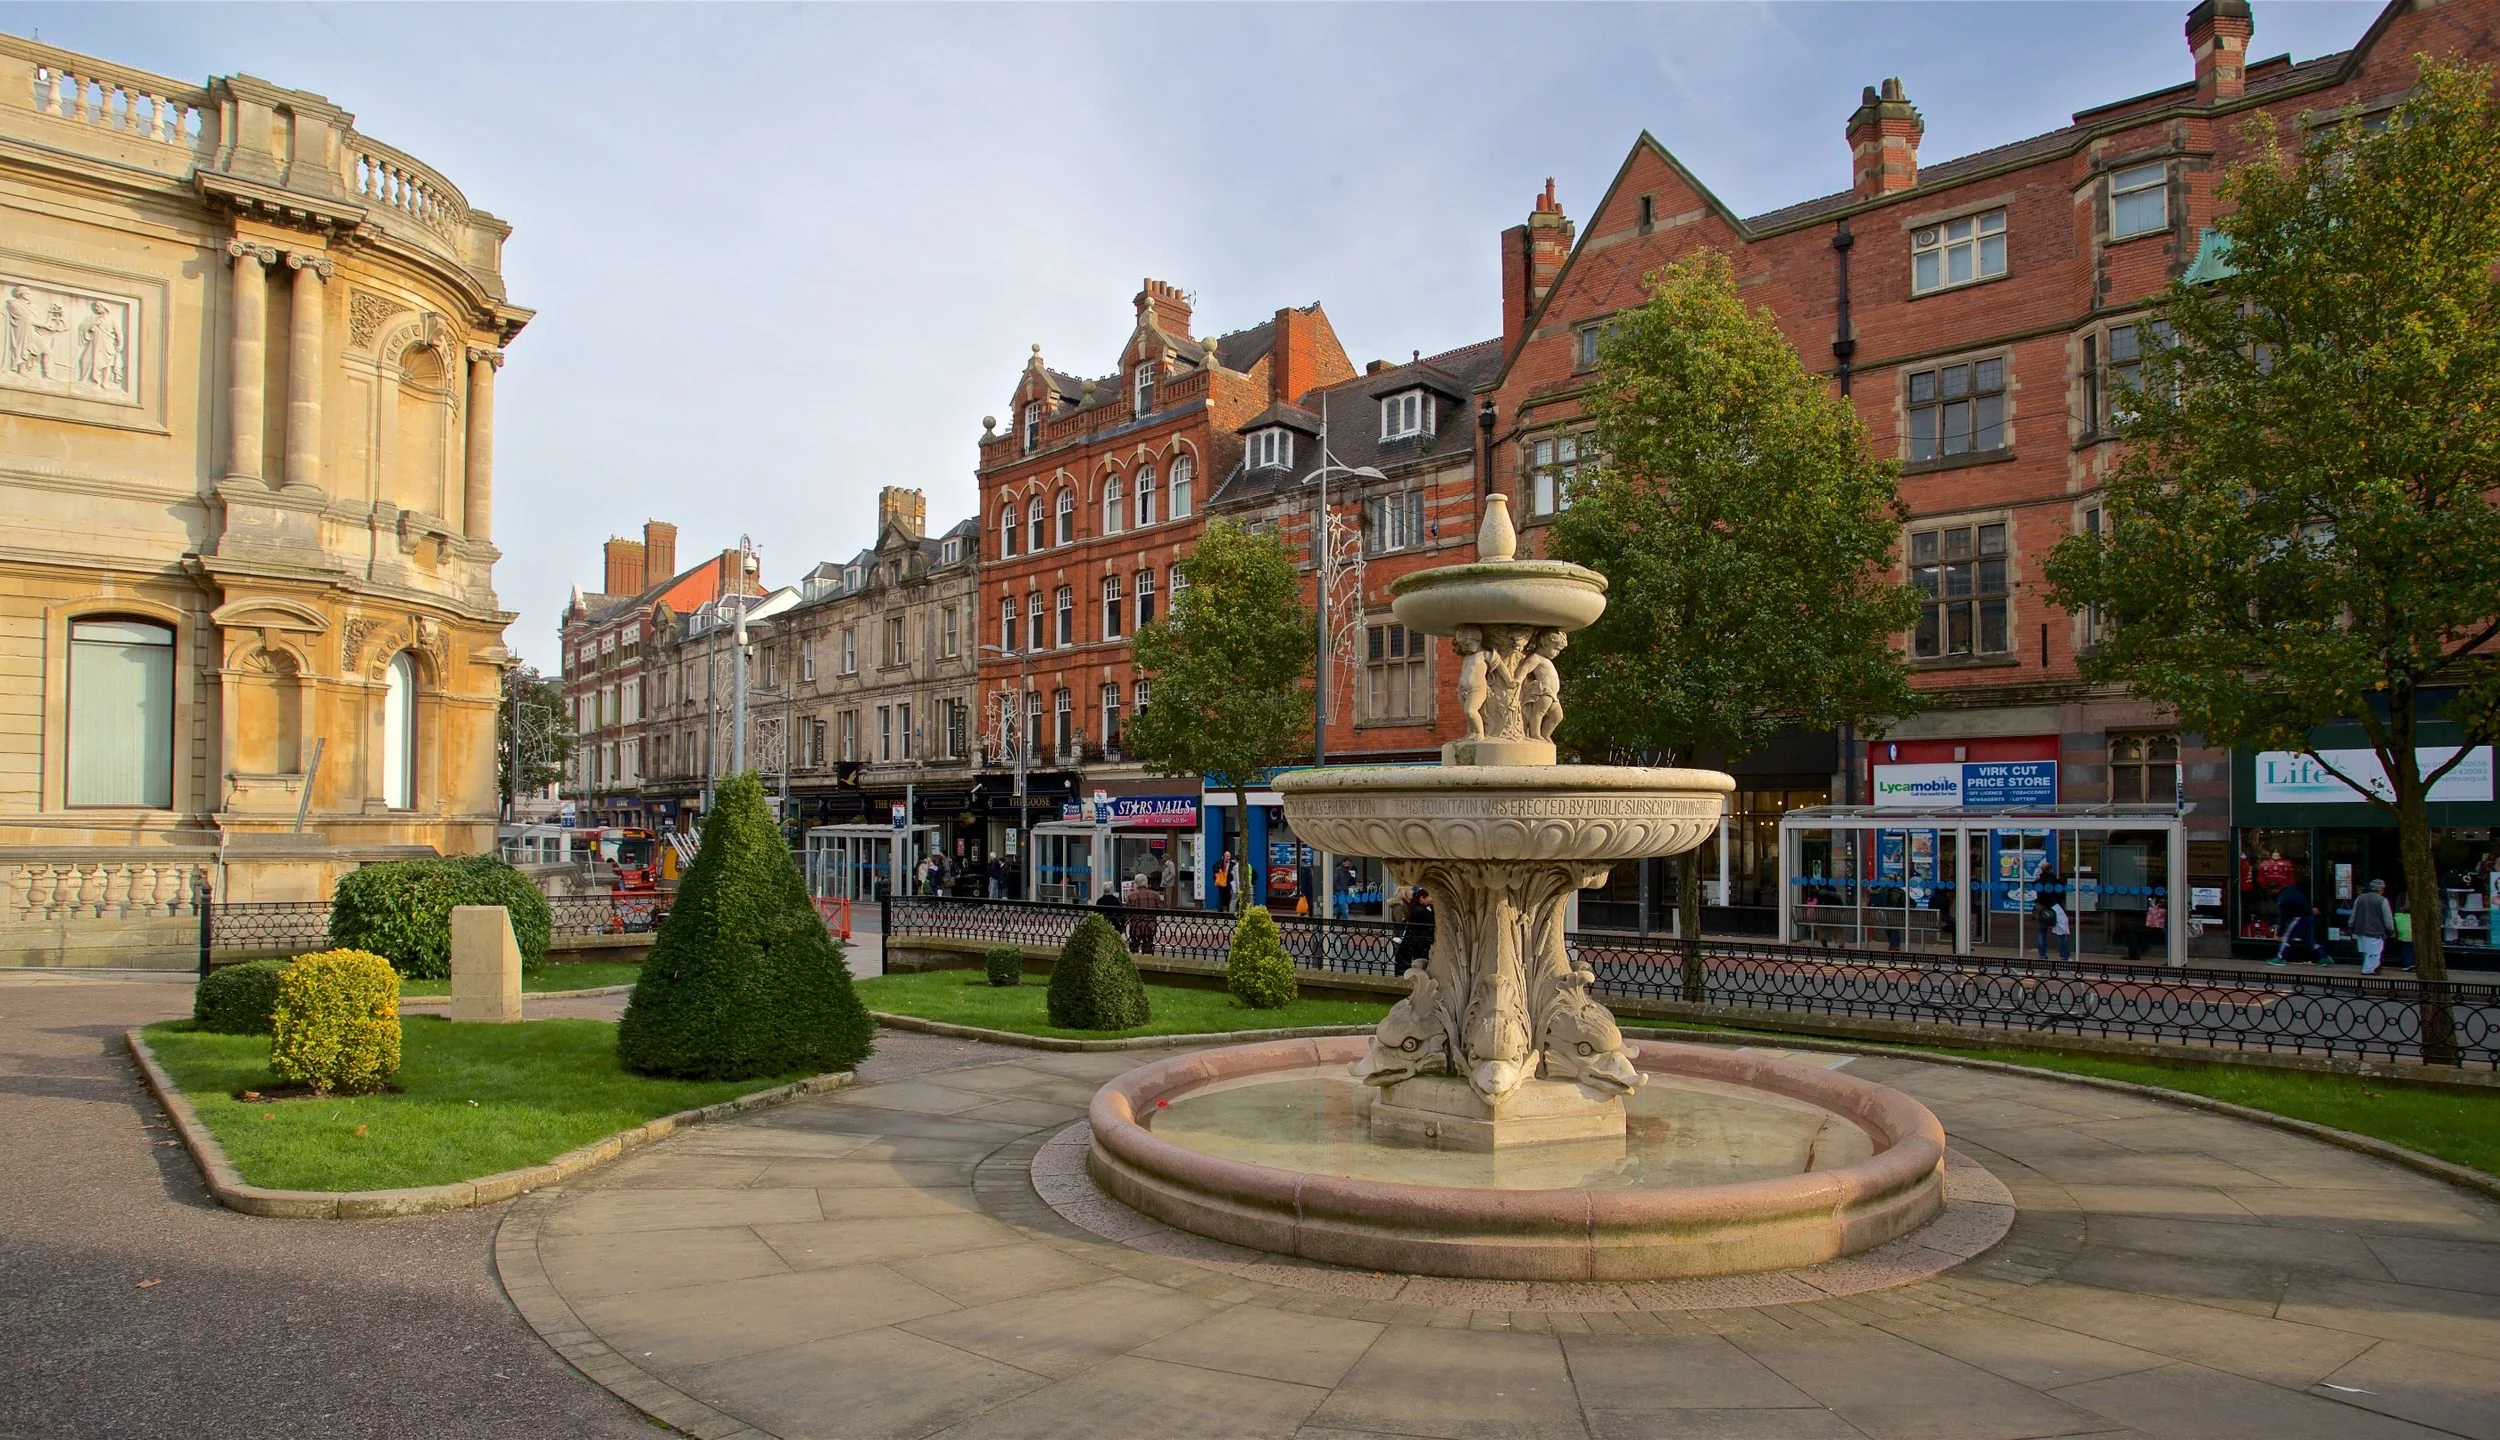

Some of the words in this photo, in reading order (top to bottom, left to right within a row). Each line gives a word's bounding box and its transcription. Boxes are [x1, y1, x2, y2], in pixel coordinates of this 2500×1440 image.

[1979, 767, 2008, 777] VIRK
[2012, 766, 2038, 776] CUT
[2264, 760, 2330, 785] Life
[1879, 780, 1957, 794] Lycamobile
[1967, 778, 2005, 787] PRICE
[2008, 777, 2051, 786] STORE
[874, 799, 888, 809] THE
[1026, 796, 1051, 807] GOOSE
[1155, 799, 1191, 816] NAILS
[1510, 800, 1566, 816] ERECTED
[1586, 800, 1624, 815] PUBLIC
